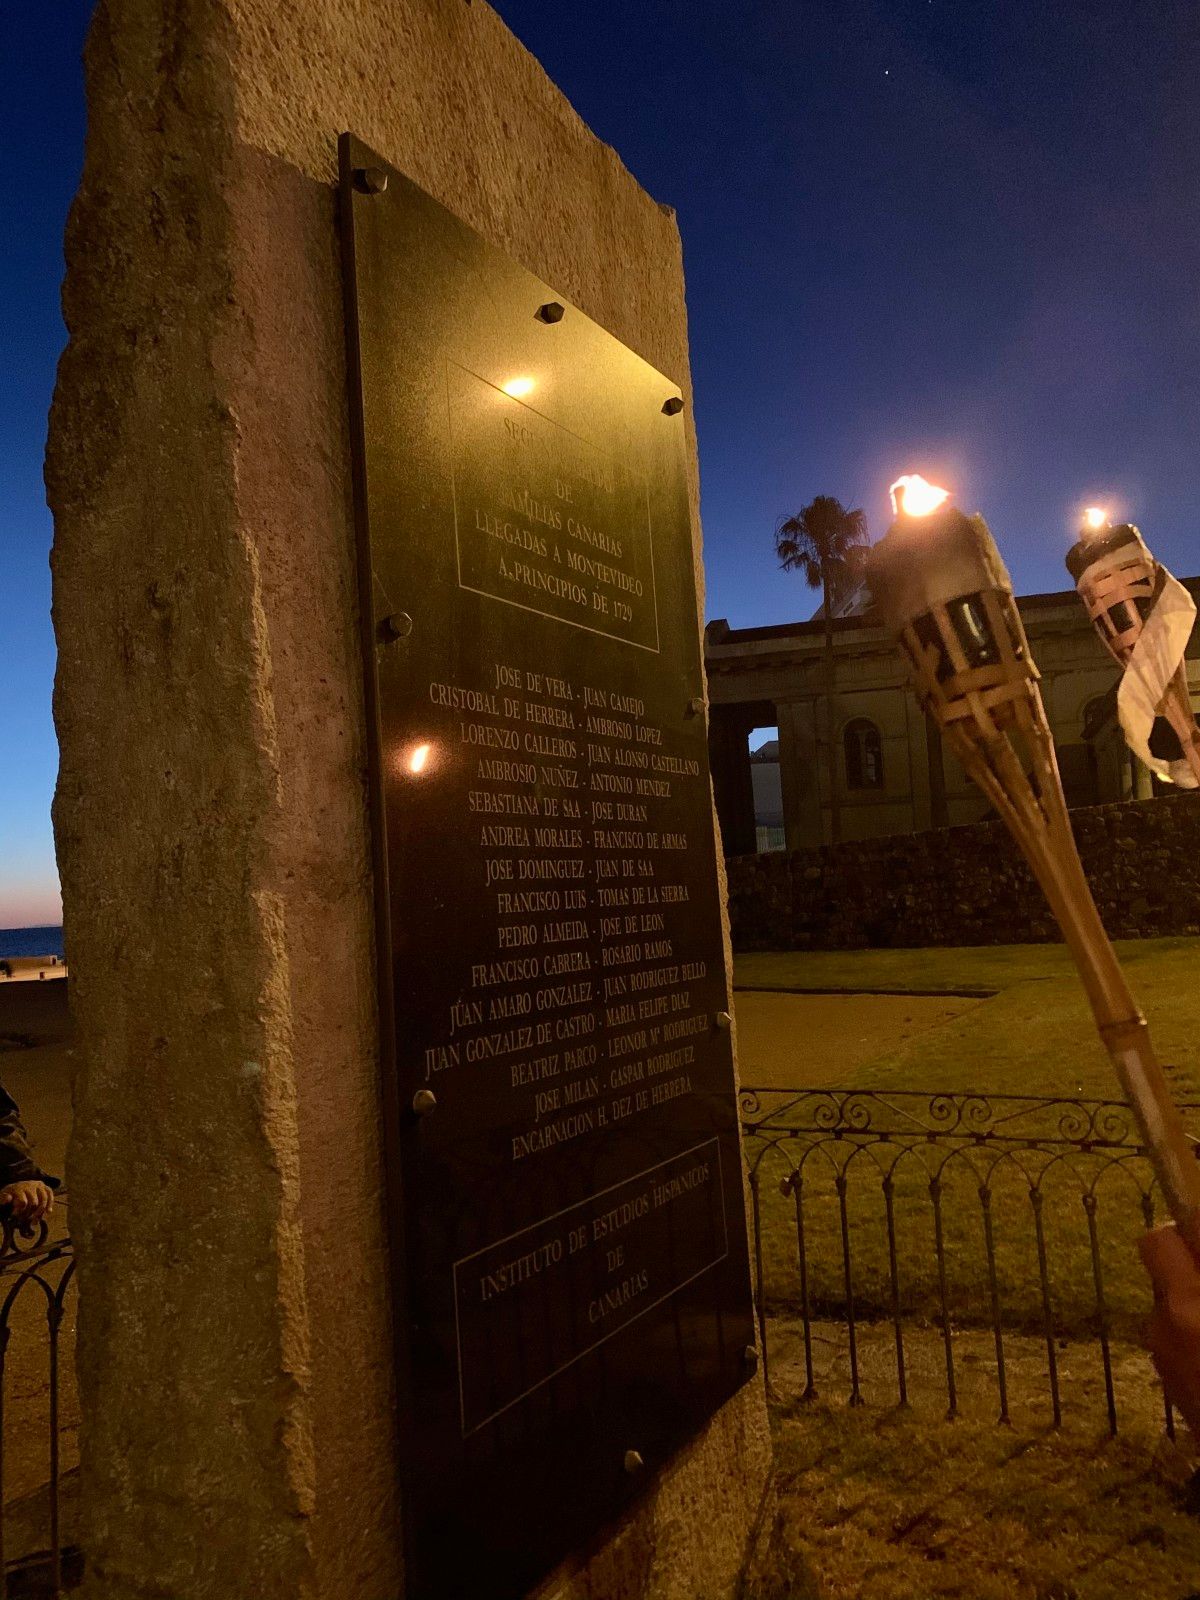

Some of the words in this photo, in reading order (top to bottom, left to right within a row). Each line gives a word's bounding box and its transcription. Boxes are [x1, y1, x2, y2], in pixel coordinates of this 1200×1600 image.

[556, 479, 573, 503] DE
[476, 510, 547, 557] LLEGADAS
[554, 546, 562, 563] A
[567, 549, 643, 597] MONTEVIDEO
[568, 518, 622, 558] CANARIAS
[514, 561, 587, 605] PRINCIPIOS
[593, 592, 609, 614] DE
[614, 601, 633, 622] 1729
[430, 683, 499, 715] CRISTOBAL
[504, 698, 520, 719] DE
[526, 703, 575, 730] HERRERA
[586, 715, 632, 740] AMBROSIO
[635, 726, 662, 745] LOPEZ
[495, 664, 521, 690] JOSE
[527, 672, 541, 693] DE
[546, 678, 574, 700] VERA
[584, 686, 606, 708] JUAN
[610, 693, 645, 719] CAMEJO
[460, 723, 519, 750] LORENZO
[525, 733, 577, 759] CALLEROS
[587, 744, 610, 767] JUAN
[615, 749, 648, 769] ALONSO
[652, 755, 699, 776] CASTELLANO
[478, 760, 536, 784] AMBROSIO
[590, 773, 633, 794] ANTONIO
[636, 778, 671, 797] MENDEZ
[468, 791, 539, 815] SEBASTIANA
[544, 797, 558, 816] DE
[563, 799, 581, 818] SAA
[591, 801, 613, 824] JOSE
[617, 803, 647, 822] DURAN
[480, 826, 530, 847] ANDREA
[535, 828, 582, 848] MORALES
[594, 831, 644, 848] FRANCISCO
[647, 832, 659, 849] DE
[662, 833, 687, 850] ARMAS
[486, 859, 513, 887] JOSE
[518, 859, 584, 879] DOMINGUEZ
[596, 859, 618, 883] JUAN
[623, 859, 634, 877] DE
[638, 859, 654, 876] SAA
[498, 891, 560, 913] FRANCISCO
[565, 890, 587, 910] LUIS
[598, 888, 629, 906] TOMAS
[633, 887, 645, 904] DE
[648, 886, 659, 903] LA
[662, 885, 690, 903] SIERRA
[498, 925, 537, 947] PEDRO
[543, 920, 589, 943] ALMEIDA
[599, 917, 621, 941] JOSE
[625, 915, 637, 933] DE
[641, 913, 665, 931] LEON
[472, 959, 538, 987] FRANCISCO
[544, 952, 590, 976] CABRERA
[602, 943, 641, 966] ROSARIO
[645, 940, 672, 960] RAMOS
[450, 1002, 483, 1036] JUAN
[490, 994, 532, 1020] AMARO
[536, 982, 592, 1010] GONZALEZ
[603, 975, 627, 1003] JUAN
[631, 966, 679, 991] RODRIGUEZ
[682, 961, 706, 980] BELLO
[425, 1044, 461, 1081] JUAN
[466, 1030, 534, 1062] GONZALEZ
[537, 1022, 552, 1044] DE
[556, 1013, 595, 1040] CASTRO
[606, 1005, 636, 1028] MARIA
[639, 997, 668, 1018] FELIPE
[672, 992, 690, 1010] DIAZ
[510, 1054, 560, 1086] BEATRIZ
[564, 1044, 596, 1071] PARCO
[608, 1034, 646, 1058] LEONOR
[664, 1014, 708, 1042] RODRIGUEZ
[534, 1088, 560, 1122] JOSE
[564, 1077, 598, 1106] MILAN
[610, 1062, 644, 1088] GASPAR
[648, 1045, 695, 1070] RODRIGUEZ
[512, 1112, 594, 1160] ENCARNACION
[636, 1092, 649, 1112] DE
[652, 1076, 692, 1105] HERRERA
[480, 1239, 562, 1301] INSTITUTO
[568, 1225, 587, 1254] DE
[593, 1194, 648, 1240] ESTUDIOS
[653, 1163, 709, 1208] HISPANICOS
[607, 1245, 625, 1272] DE
[589, 1269, 649, 1323] CANARIAS
